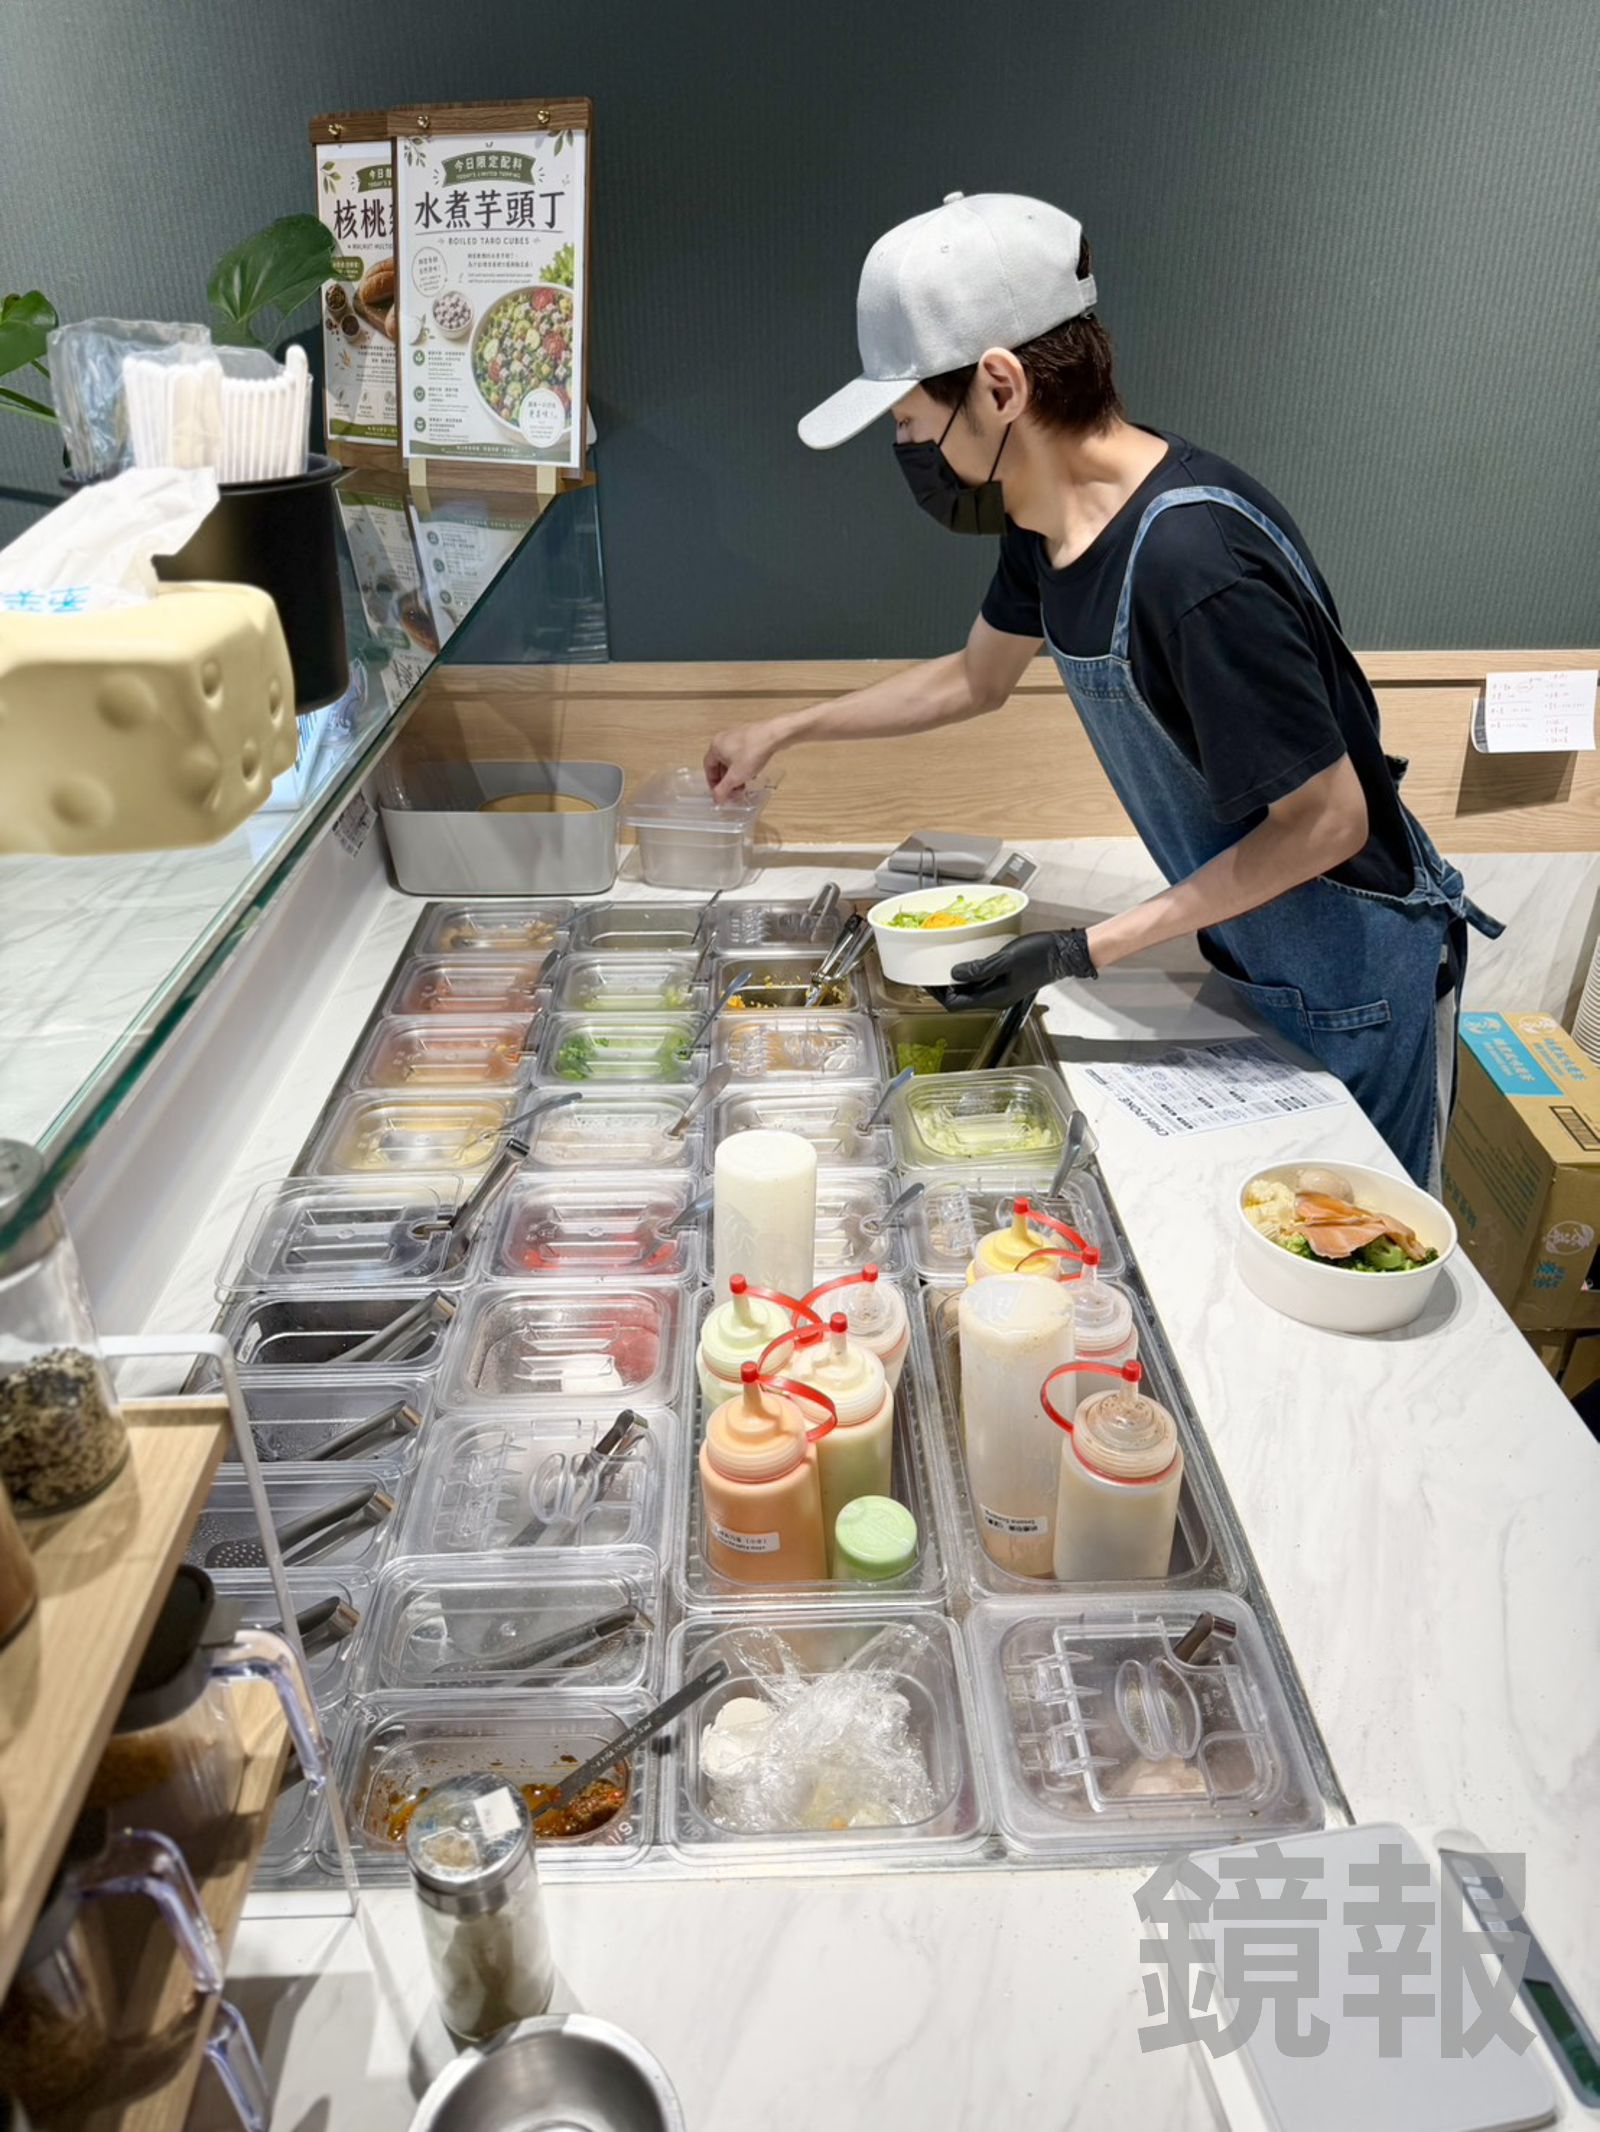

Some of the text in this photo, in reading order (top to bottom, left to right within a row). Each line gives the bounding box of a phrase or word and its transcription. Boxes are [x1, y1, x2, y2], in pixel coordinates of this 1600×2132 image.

[334, 199, 394, 239] 核桃
[414, 189, 565, 229] 水煮芋頭丁
[448, 236, 530, 245] BOILED TARO CUBES
